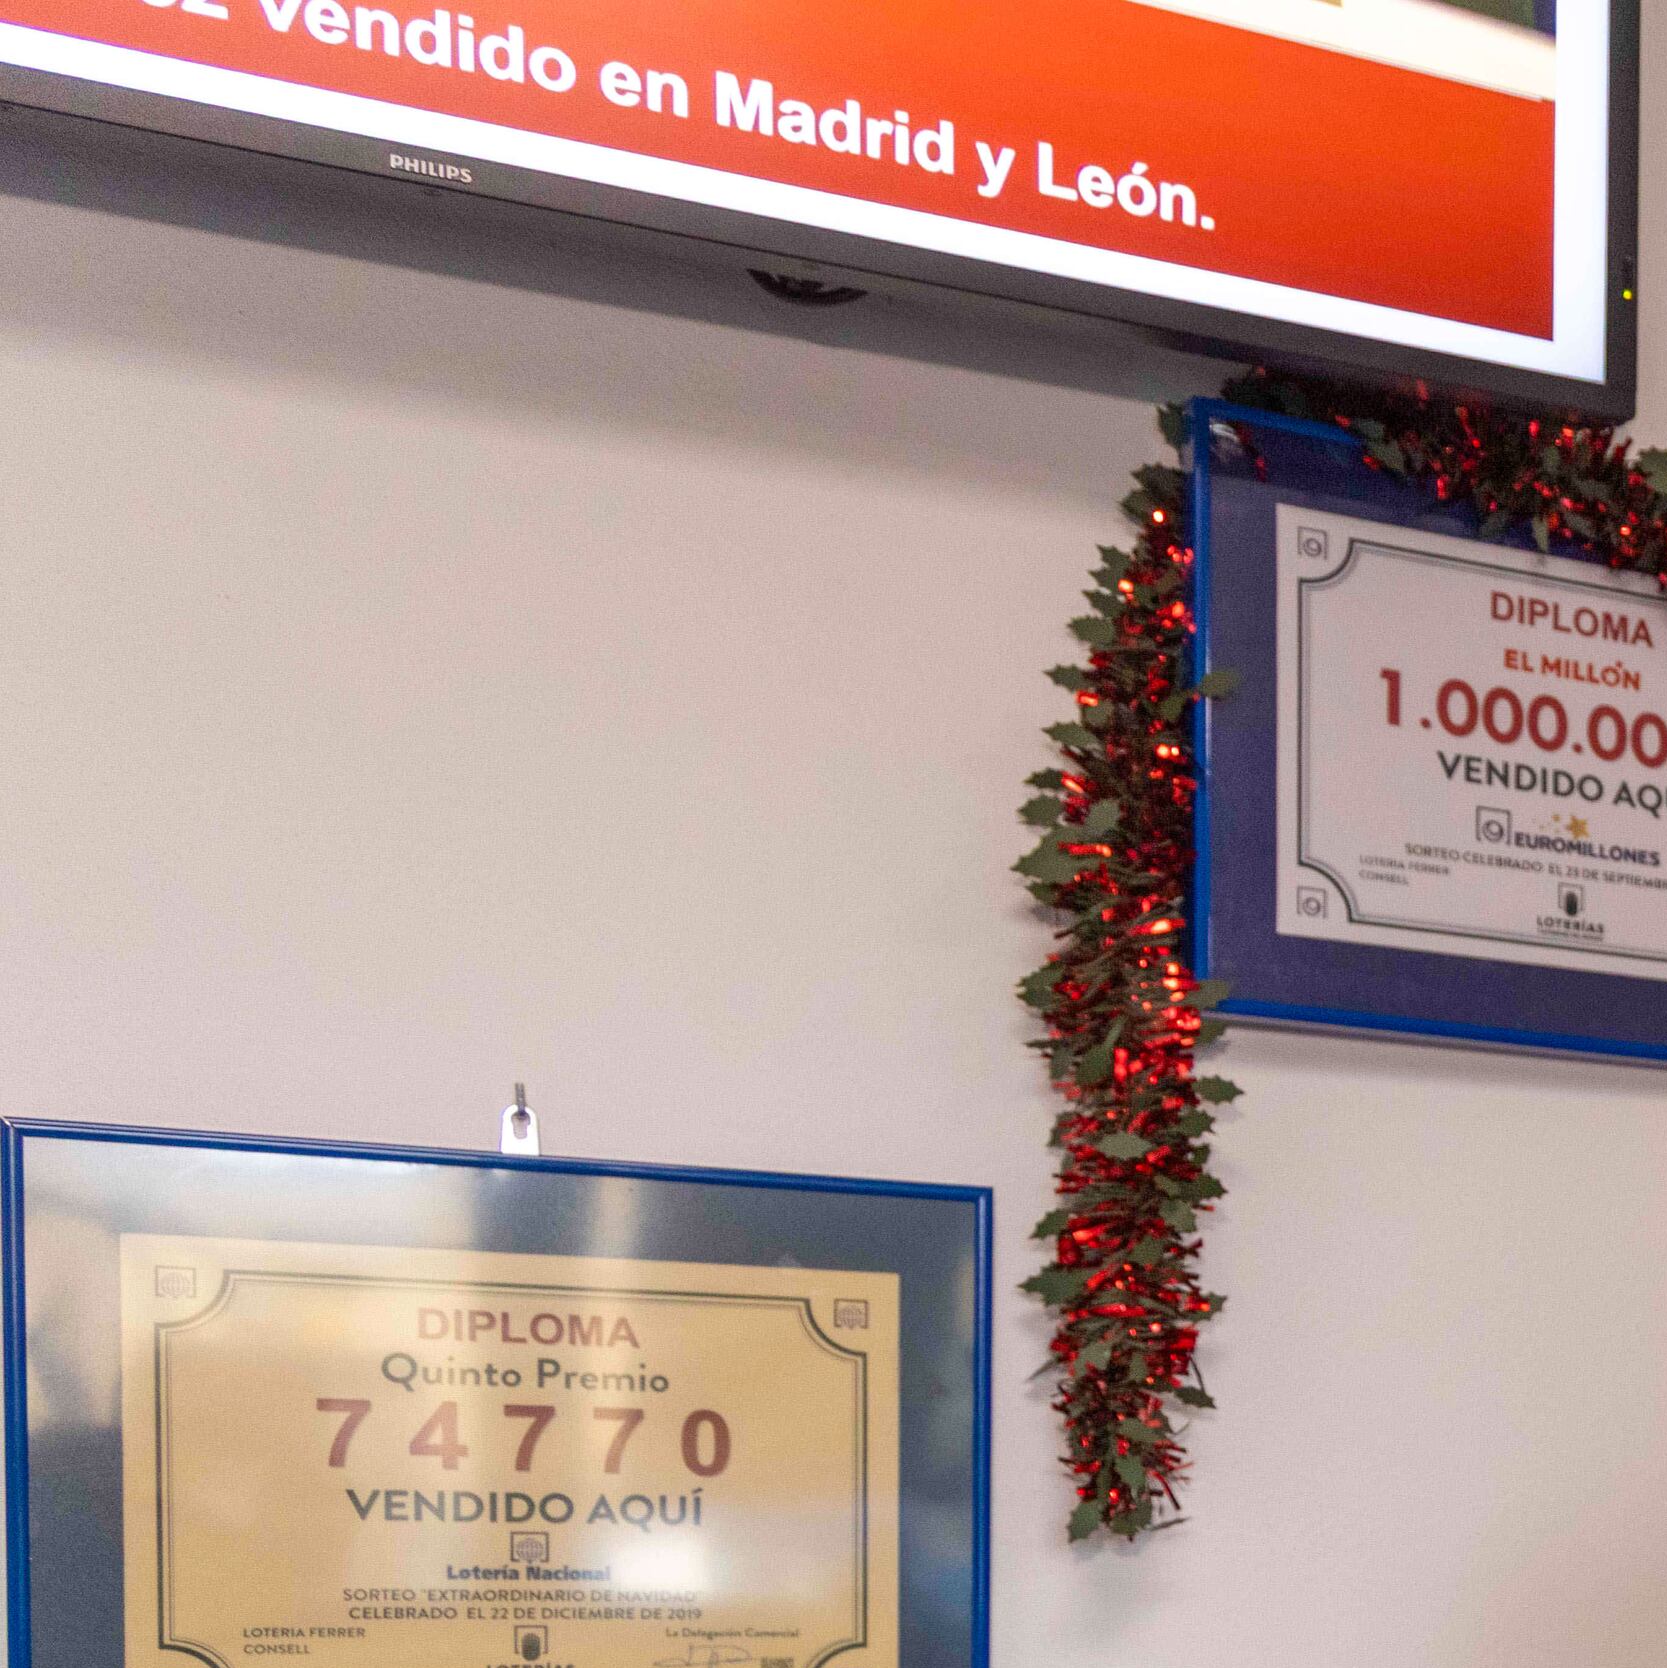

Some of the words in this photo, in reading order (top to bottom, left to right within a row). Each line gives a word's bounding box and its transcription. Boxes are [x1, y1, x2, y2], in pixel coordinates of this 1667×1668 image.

[599, 59, 690, 119] en
[714, 69, 955, 176] Madrid
[975, 140, 1017, 199] y
[1037, 141, 1216, 231] León.
[389, 153, 473, 184] PHILIPS
[1489, 591, 1654, 649] DIPLOMA
[1503, 648, 1534, 674] EL
[1540, 655, 1642, 691] MILLÓN
[1437, 750, 1604, 802] VENDIDO
[1404, 843, 1460, 862] SORTEO
[1462, 850, 1543, 874] CELEBRADO
[1513, 831, 1661, 867] EUROMILLONES
[1536, 914, 1604, 934] LOTERÍAS
[417, 1306, 640, 1350] DIPLOMA
[380, 1352, 522, 1391] Quinto
[536, 1356, 670, 1394] Premio
[346, 1488, 575, 1524] VENDIDO
[587, 1487, 703, 1528] AQUÍ
[446, 1564, 520, 1581] Lotería
[526, 1565, 611, 1582] Nacional
[343, 1588, 416, 1602] SORTEO
[590, 1590, 614, 1602] DE
[349, 1606, 458, 1620] CELEBRADO
[466, 1607, 485, 1620] EL
[490, 1607, 510, 1620] 22
[513, 1607, 536, 1620] DE
[541, 1607, 635, 1621] DICIEMBRE
[640, 1608, 662, 1621] DE
[667, 1608, 703, 1621] 2019
[242, 1644, 310, 1655] CONSELL
[243, 1627, 305, 1639] LOTERIA
[309, 1627, 366, 1638] FERRER
